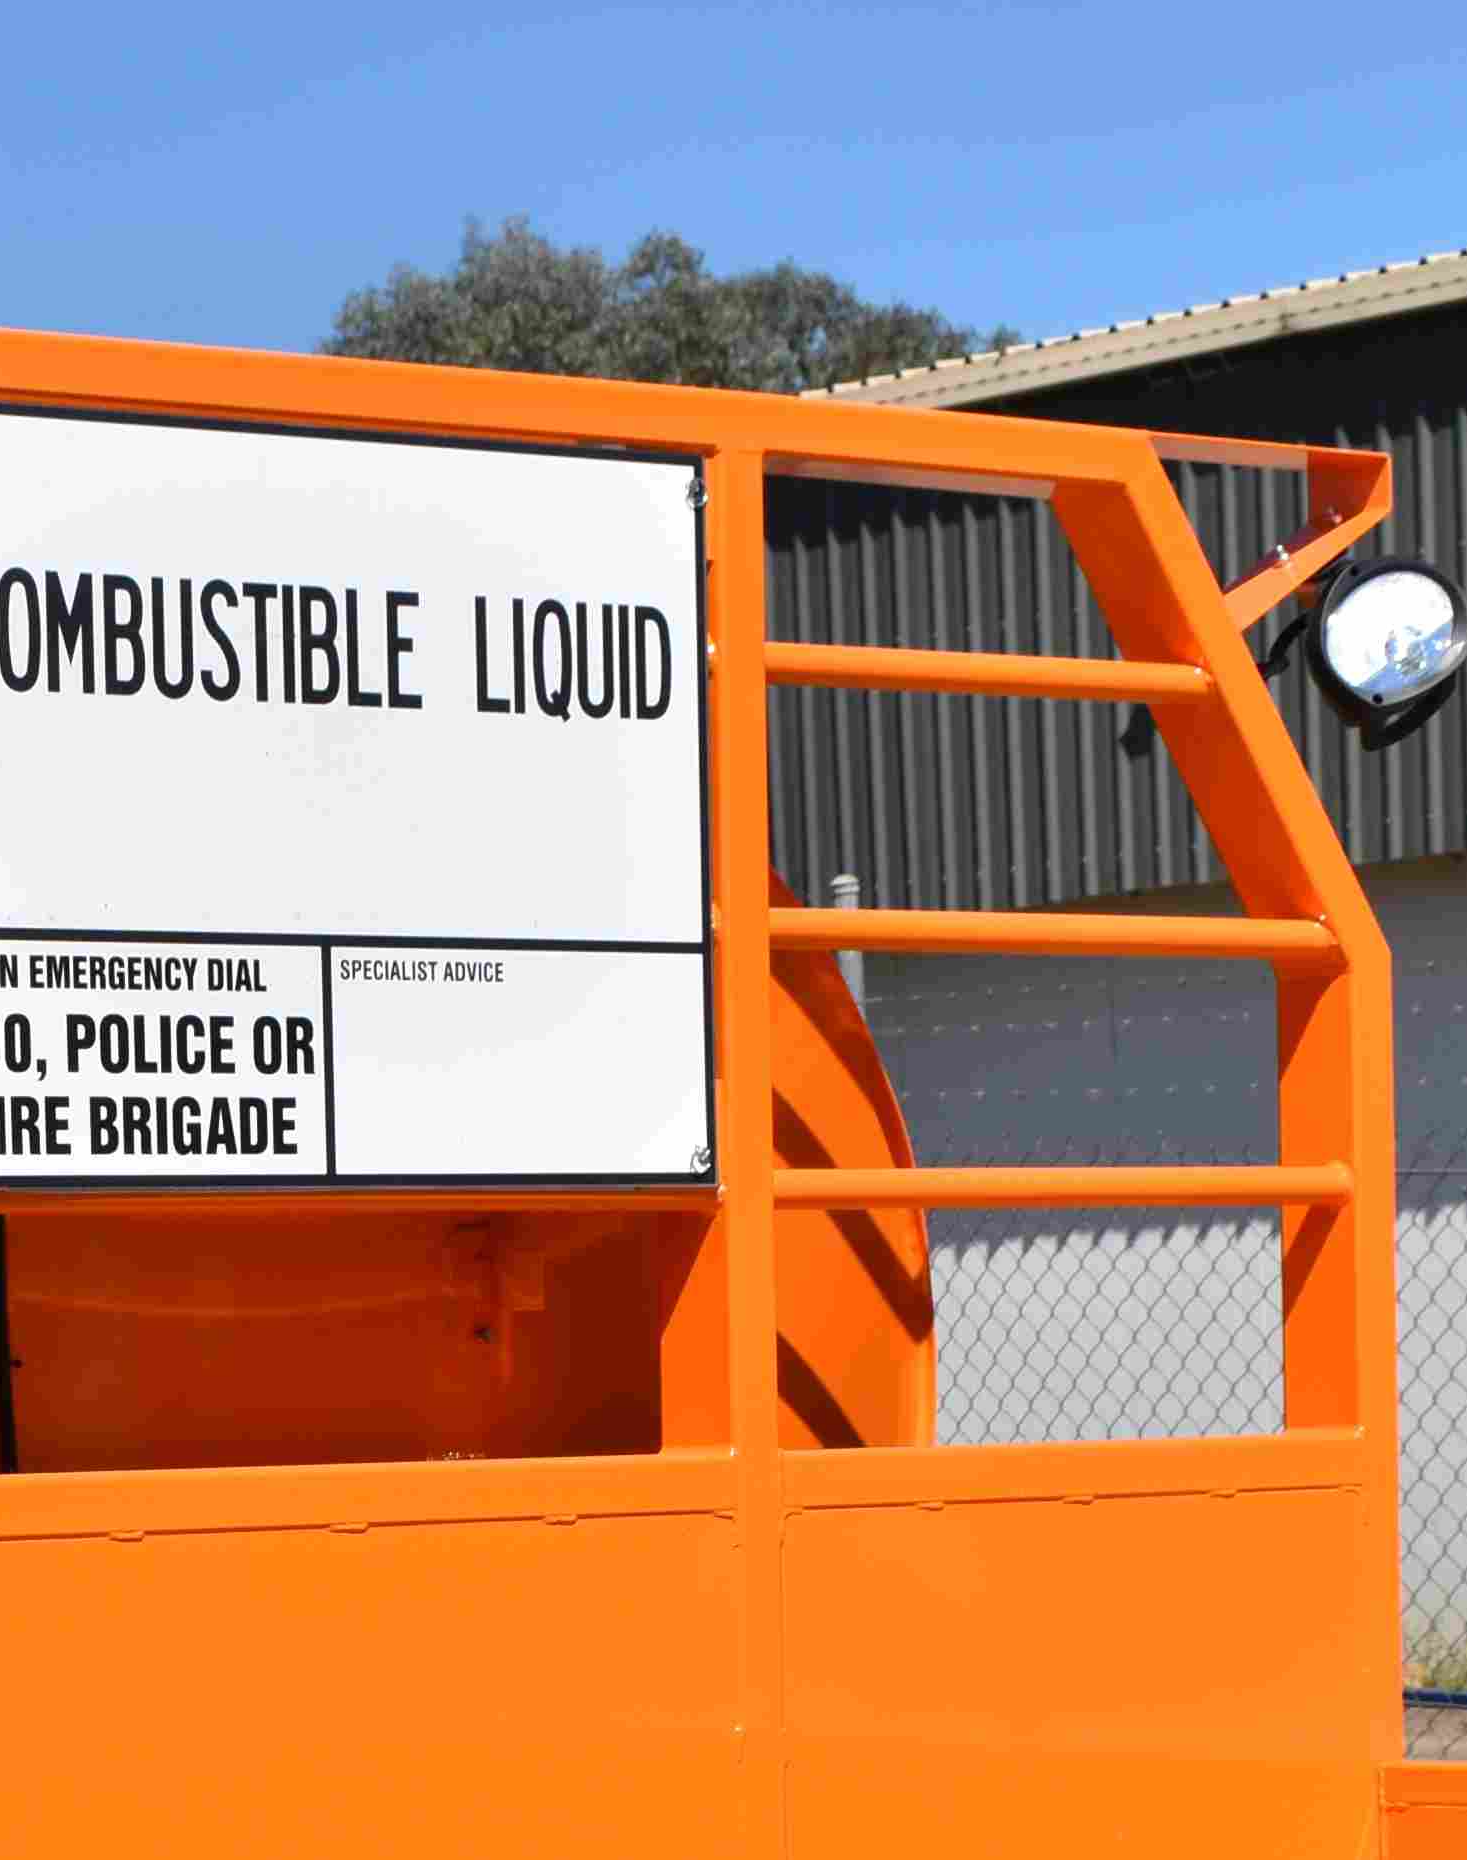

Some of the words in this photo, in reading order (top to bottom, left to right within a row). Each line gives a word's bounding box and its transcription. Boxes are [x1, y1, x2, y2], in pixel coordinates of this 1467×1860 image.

[474, 596, 673, 724] LIQUID
[30, 955, 197, 991] EMERGENCY
[207, 959, 267, 992] DIAL
[339, 959, 436, 982] SPECIALIST
[443, 961, 504, 984] ADVICE
[67, 1013, 236, 1073] POLICE
[252, 1015, 315, 1075] OR
[89, 1095, 297, 1155] BRIGADE
